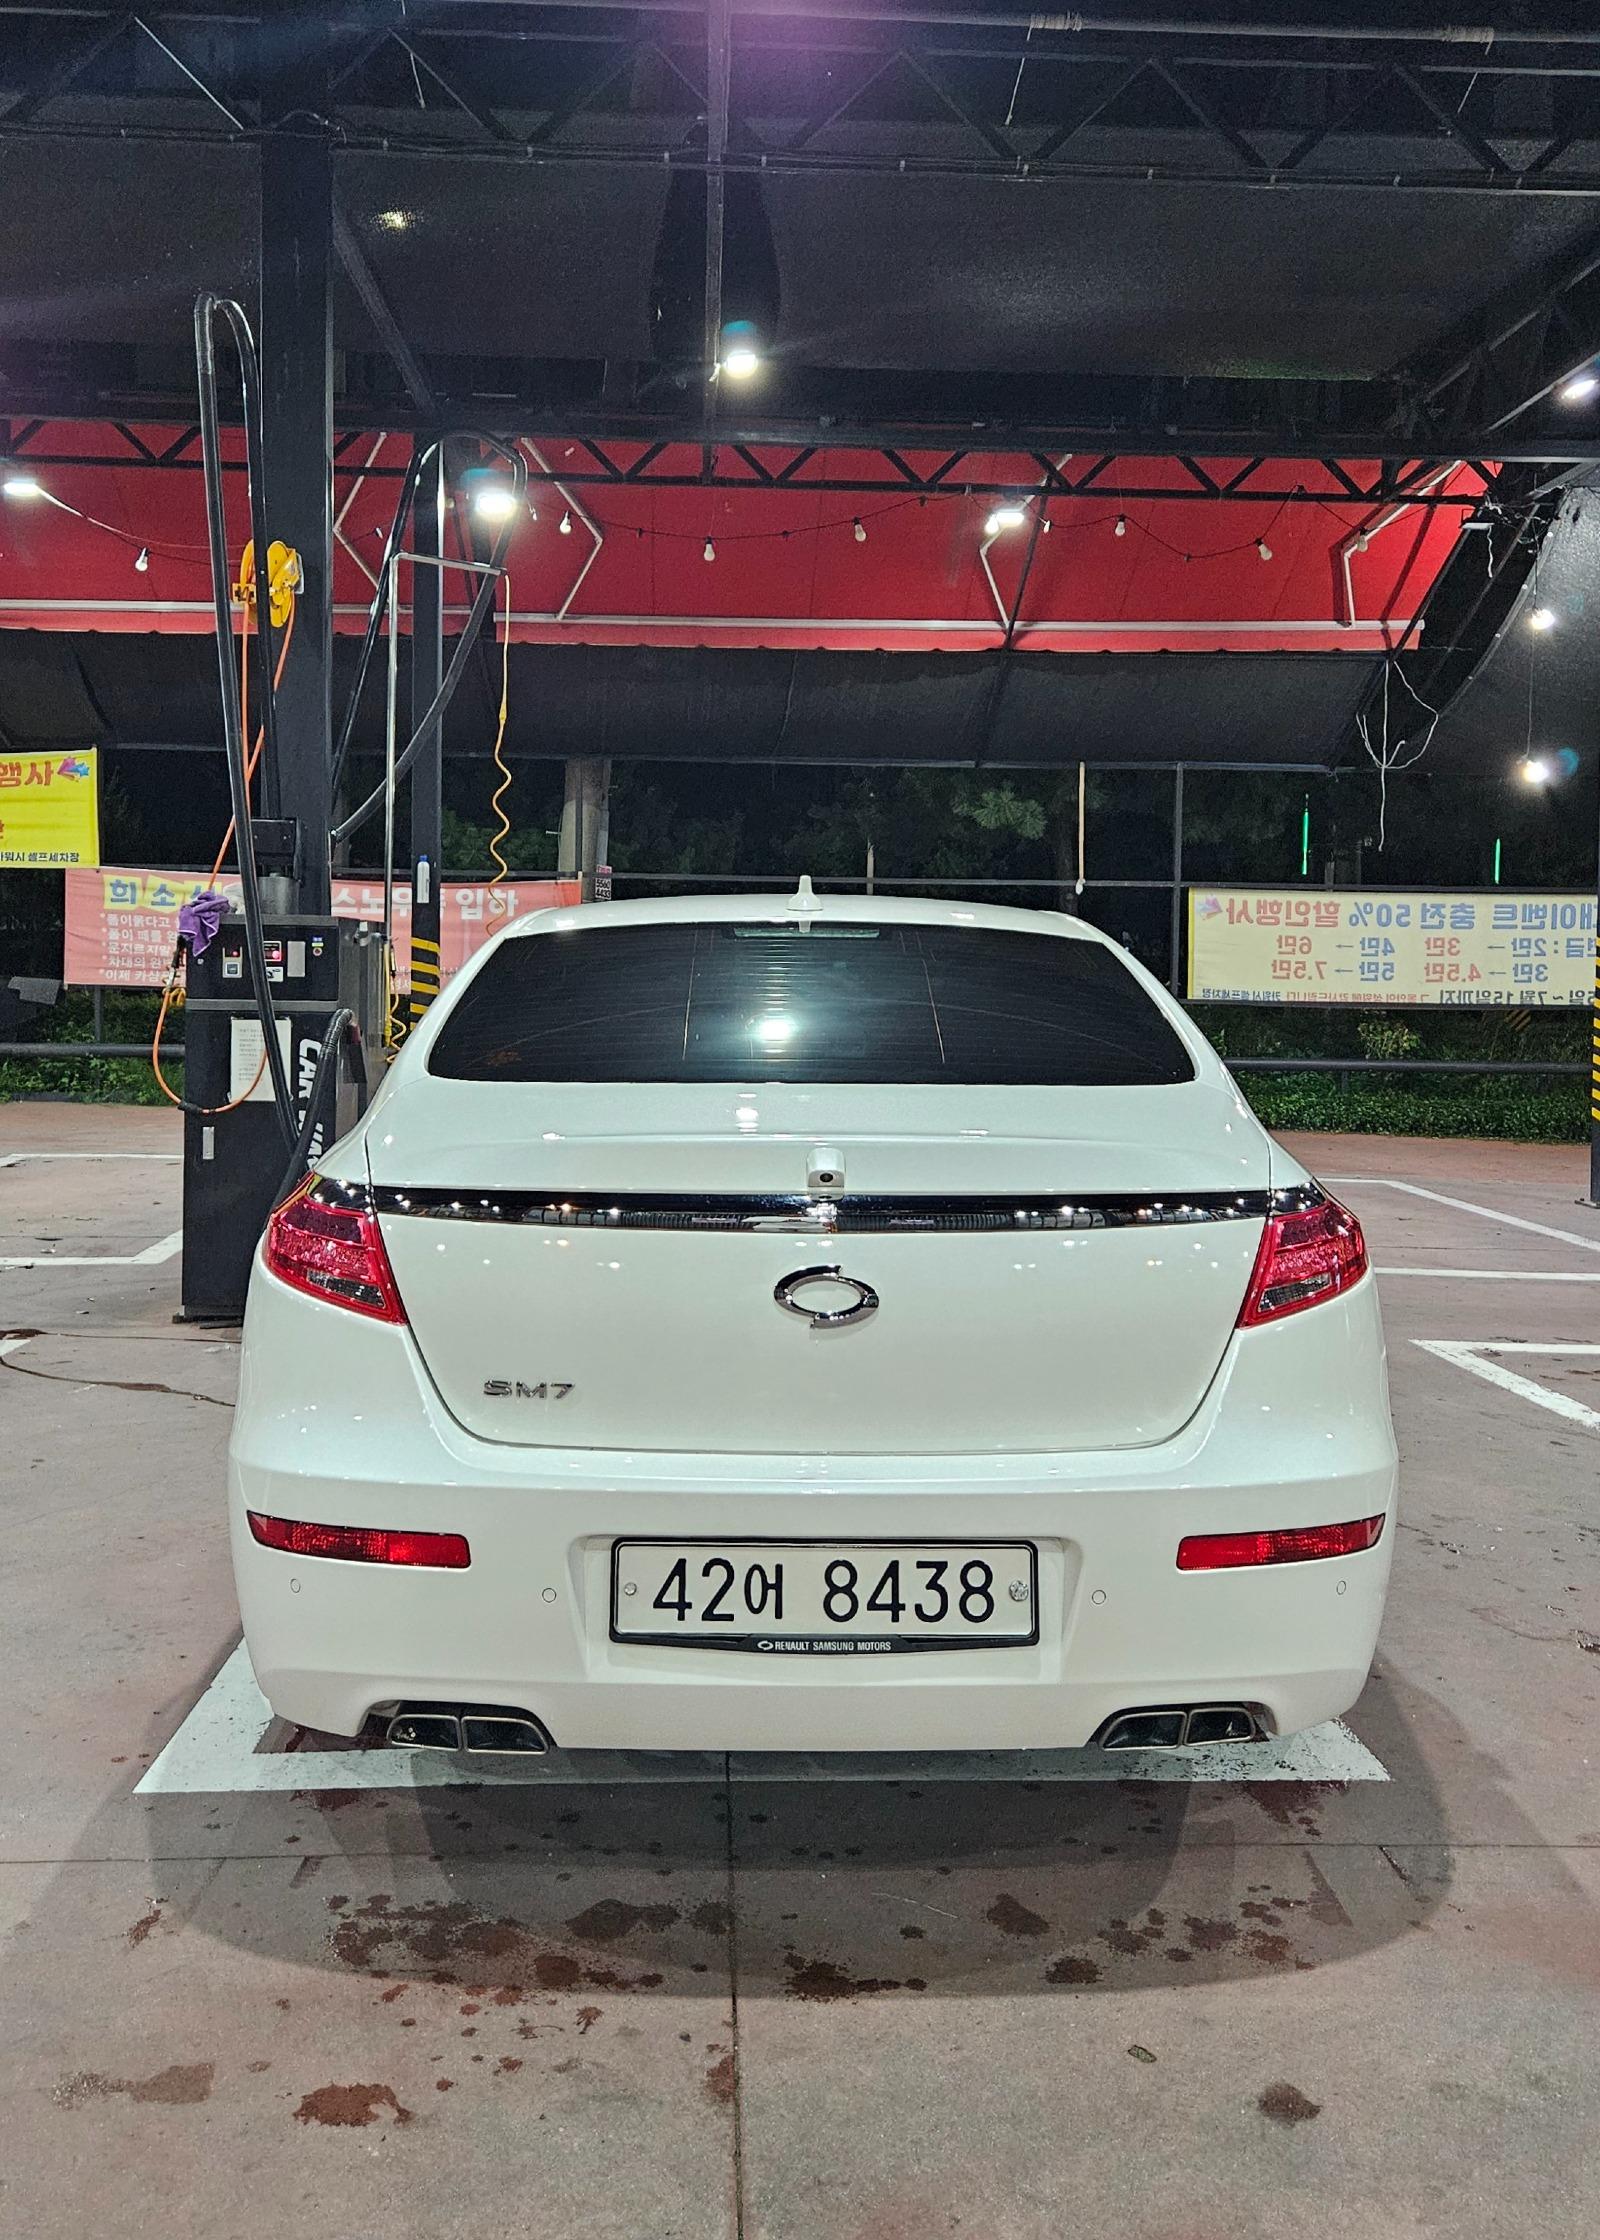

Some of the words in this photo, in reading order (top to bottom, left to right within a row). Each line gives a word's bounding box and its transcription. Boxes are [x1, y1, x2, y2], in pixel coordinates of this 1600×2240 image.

[28, 852, 80, 862] 셀프세차장
[331, 887, 446, 919] 스노우
[455, 888, 519, 920] 입하
[483, 1379, 575, 1400] SM7
[653, 1557, 783, 1622] 42어
[822, 1559, 995, 1623] 8438
[774, 1641, 810, 1651] RENAULT
[813, 1641, 854, 1651] SAMSUNG
[857, 1641, 892, 1651] MOTORS
